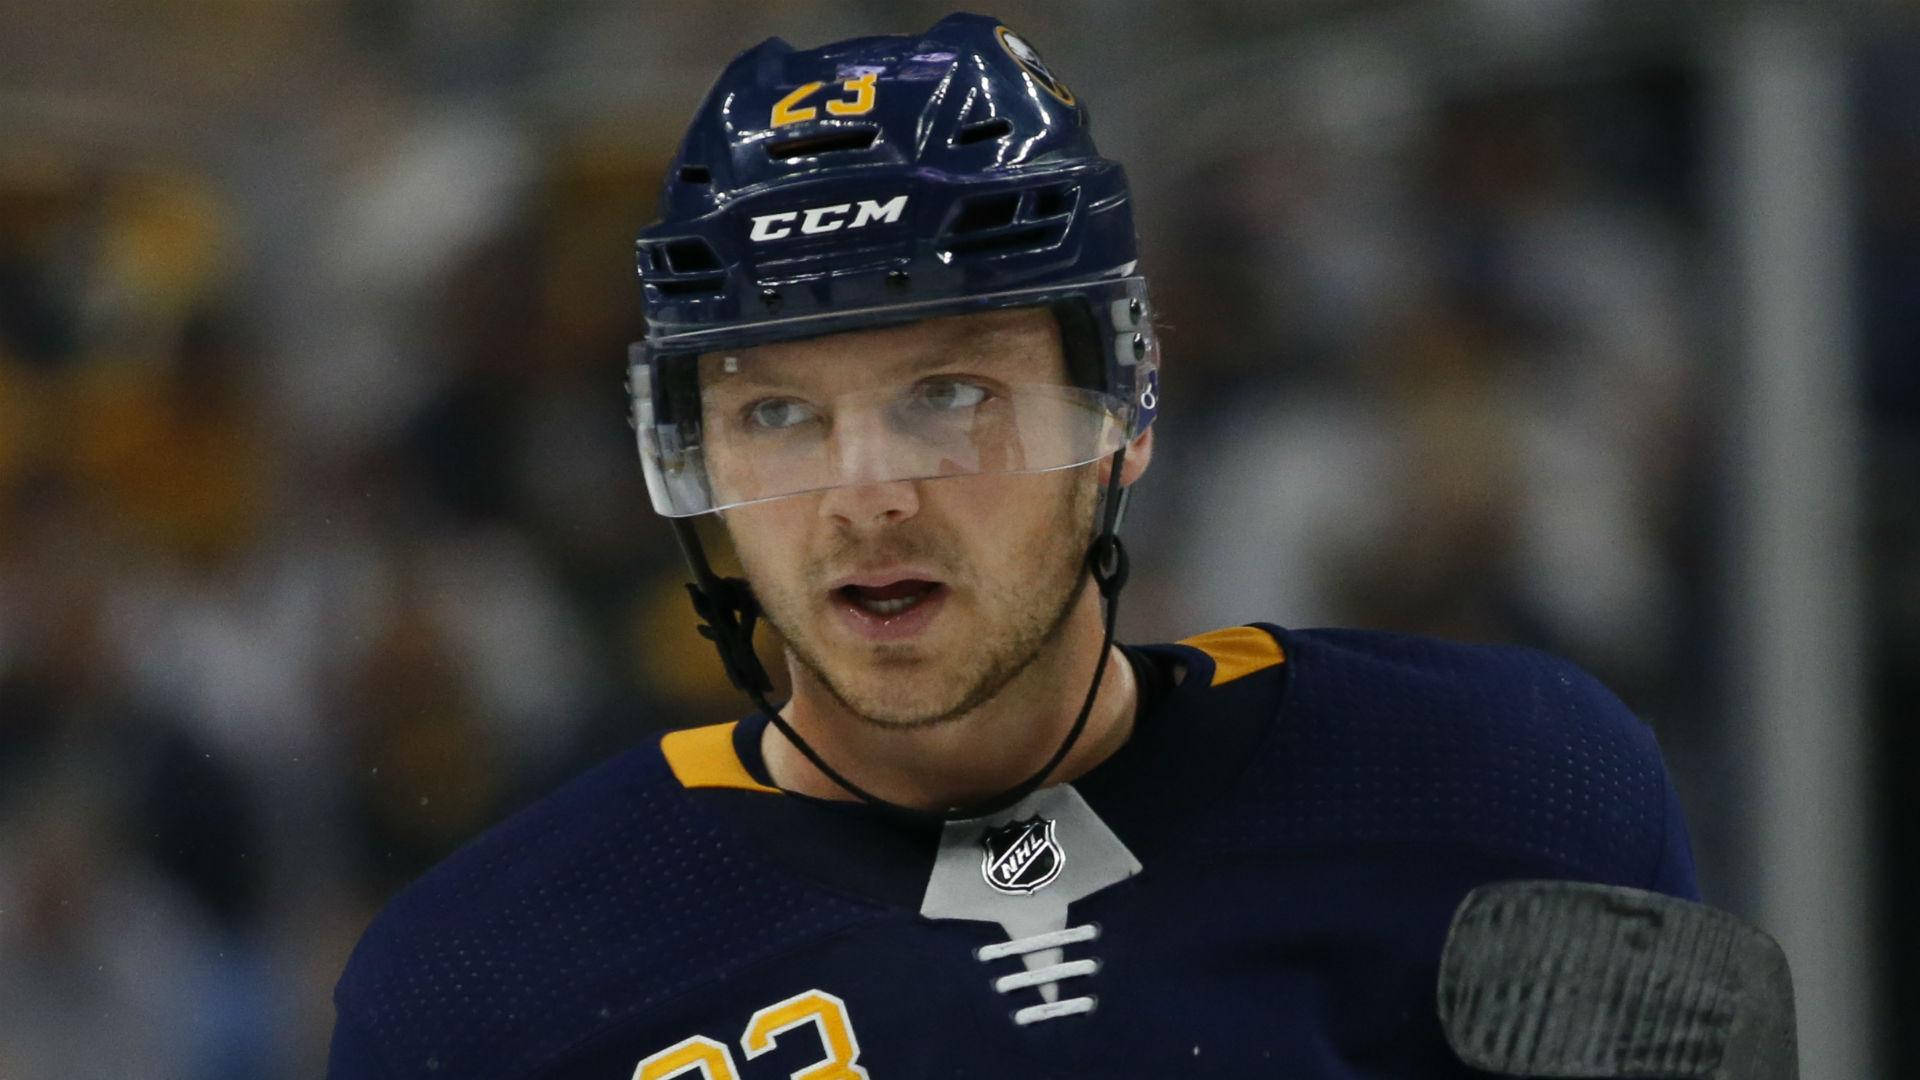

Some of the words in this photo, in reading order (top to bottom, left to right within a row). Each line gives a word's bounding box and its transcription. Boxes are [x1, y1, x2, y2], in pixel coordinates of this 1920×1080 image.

[771, 73, 877, 127] 23
[750, 196, 908, 241] CCM
[1001, 833, 1044, 880] NHL
[632, 988, 870, 1080] 3
